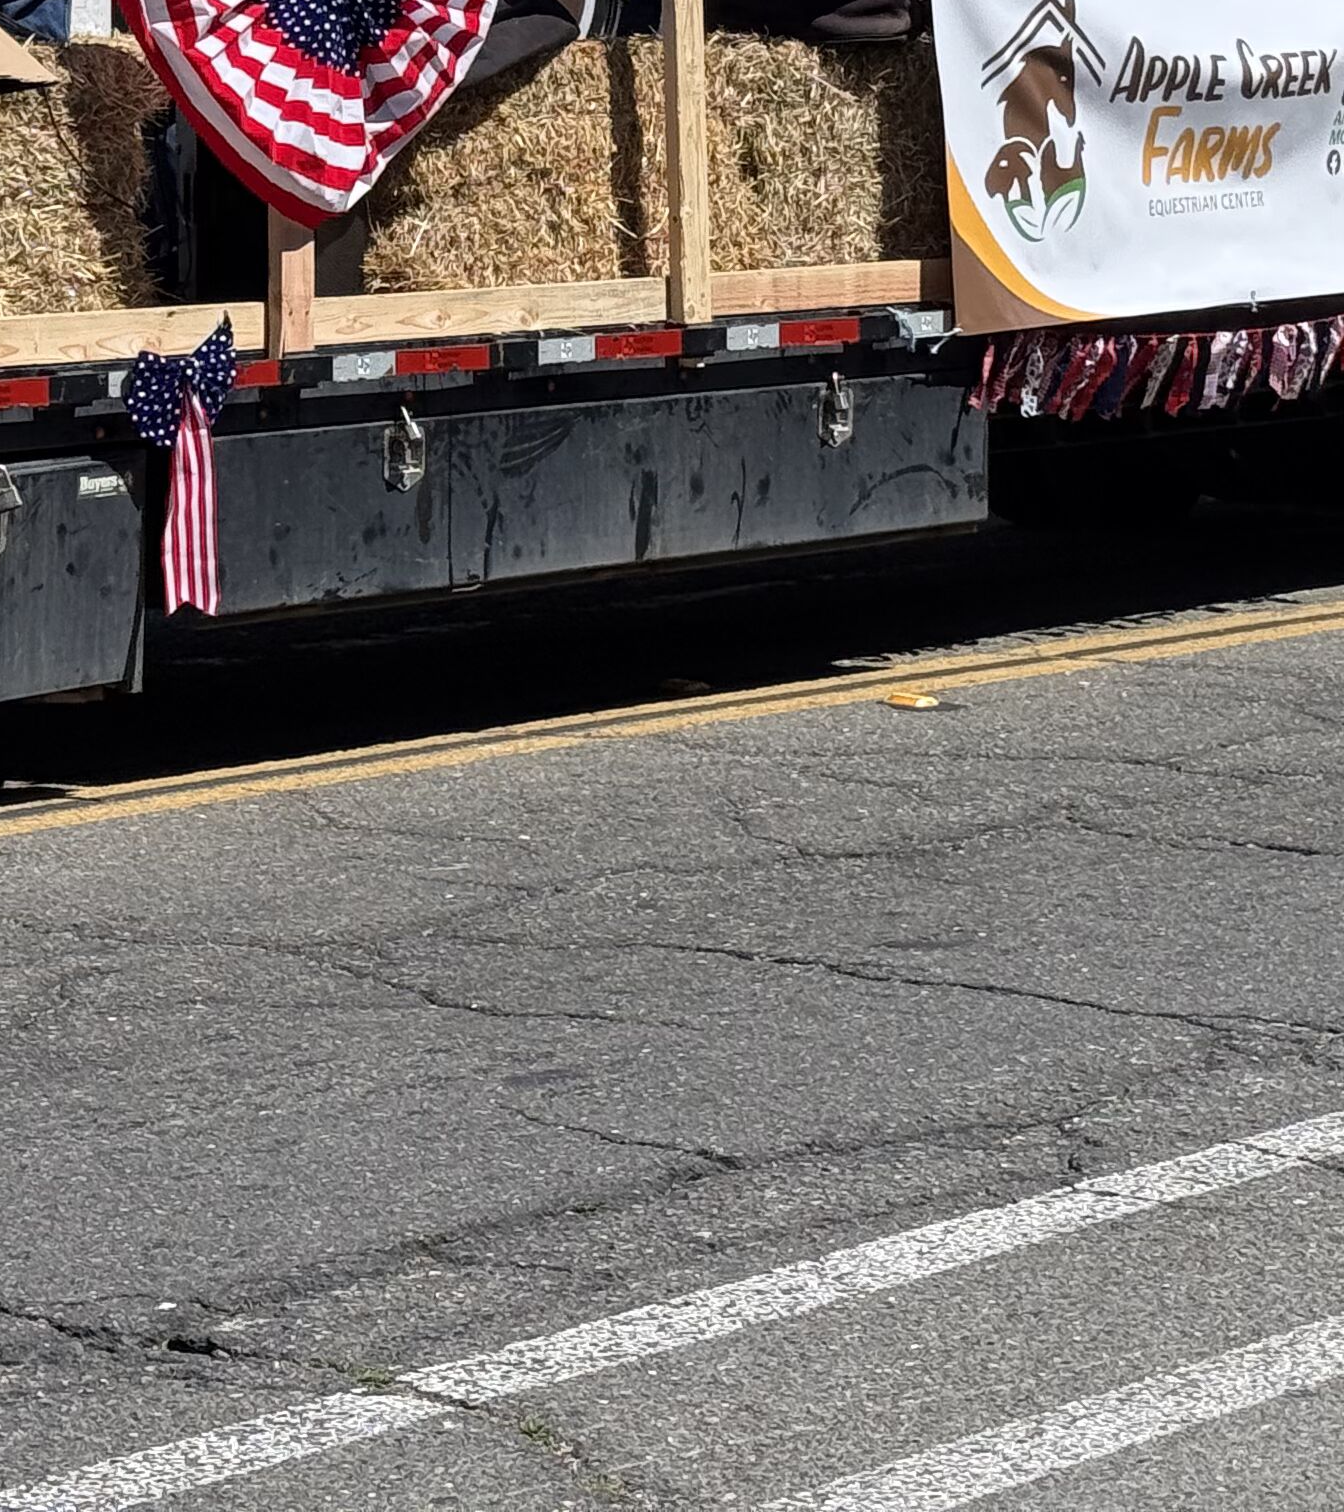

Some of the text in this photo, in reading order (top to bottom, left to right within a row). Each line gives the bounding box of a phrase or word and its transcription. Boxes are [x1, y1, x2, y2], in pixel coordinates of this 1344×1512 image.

[1109, 35, 1338, 104] APPLE CREEK
[1142, 105, 1282, 186] FARMS
[1148, 190, 1265, 217] EQUESTRIAN CENTER
